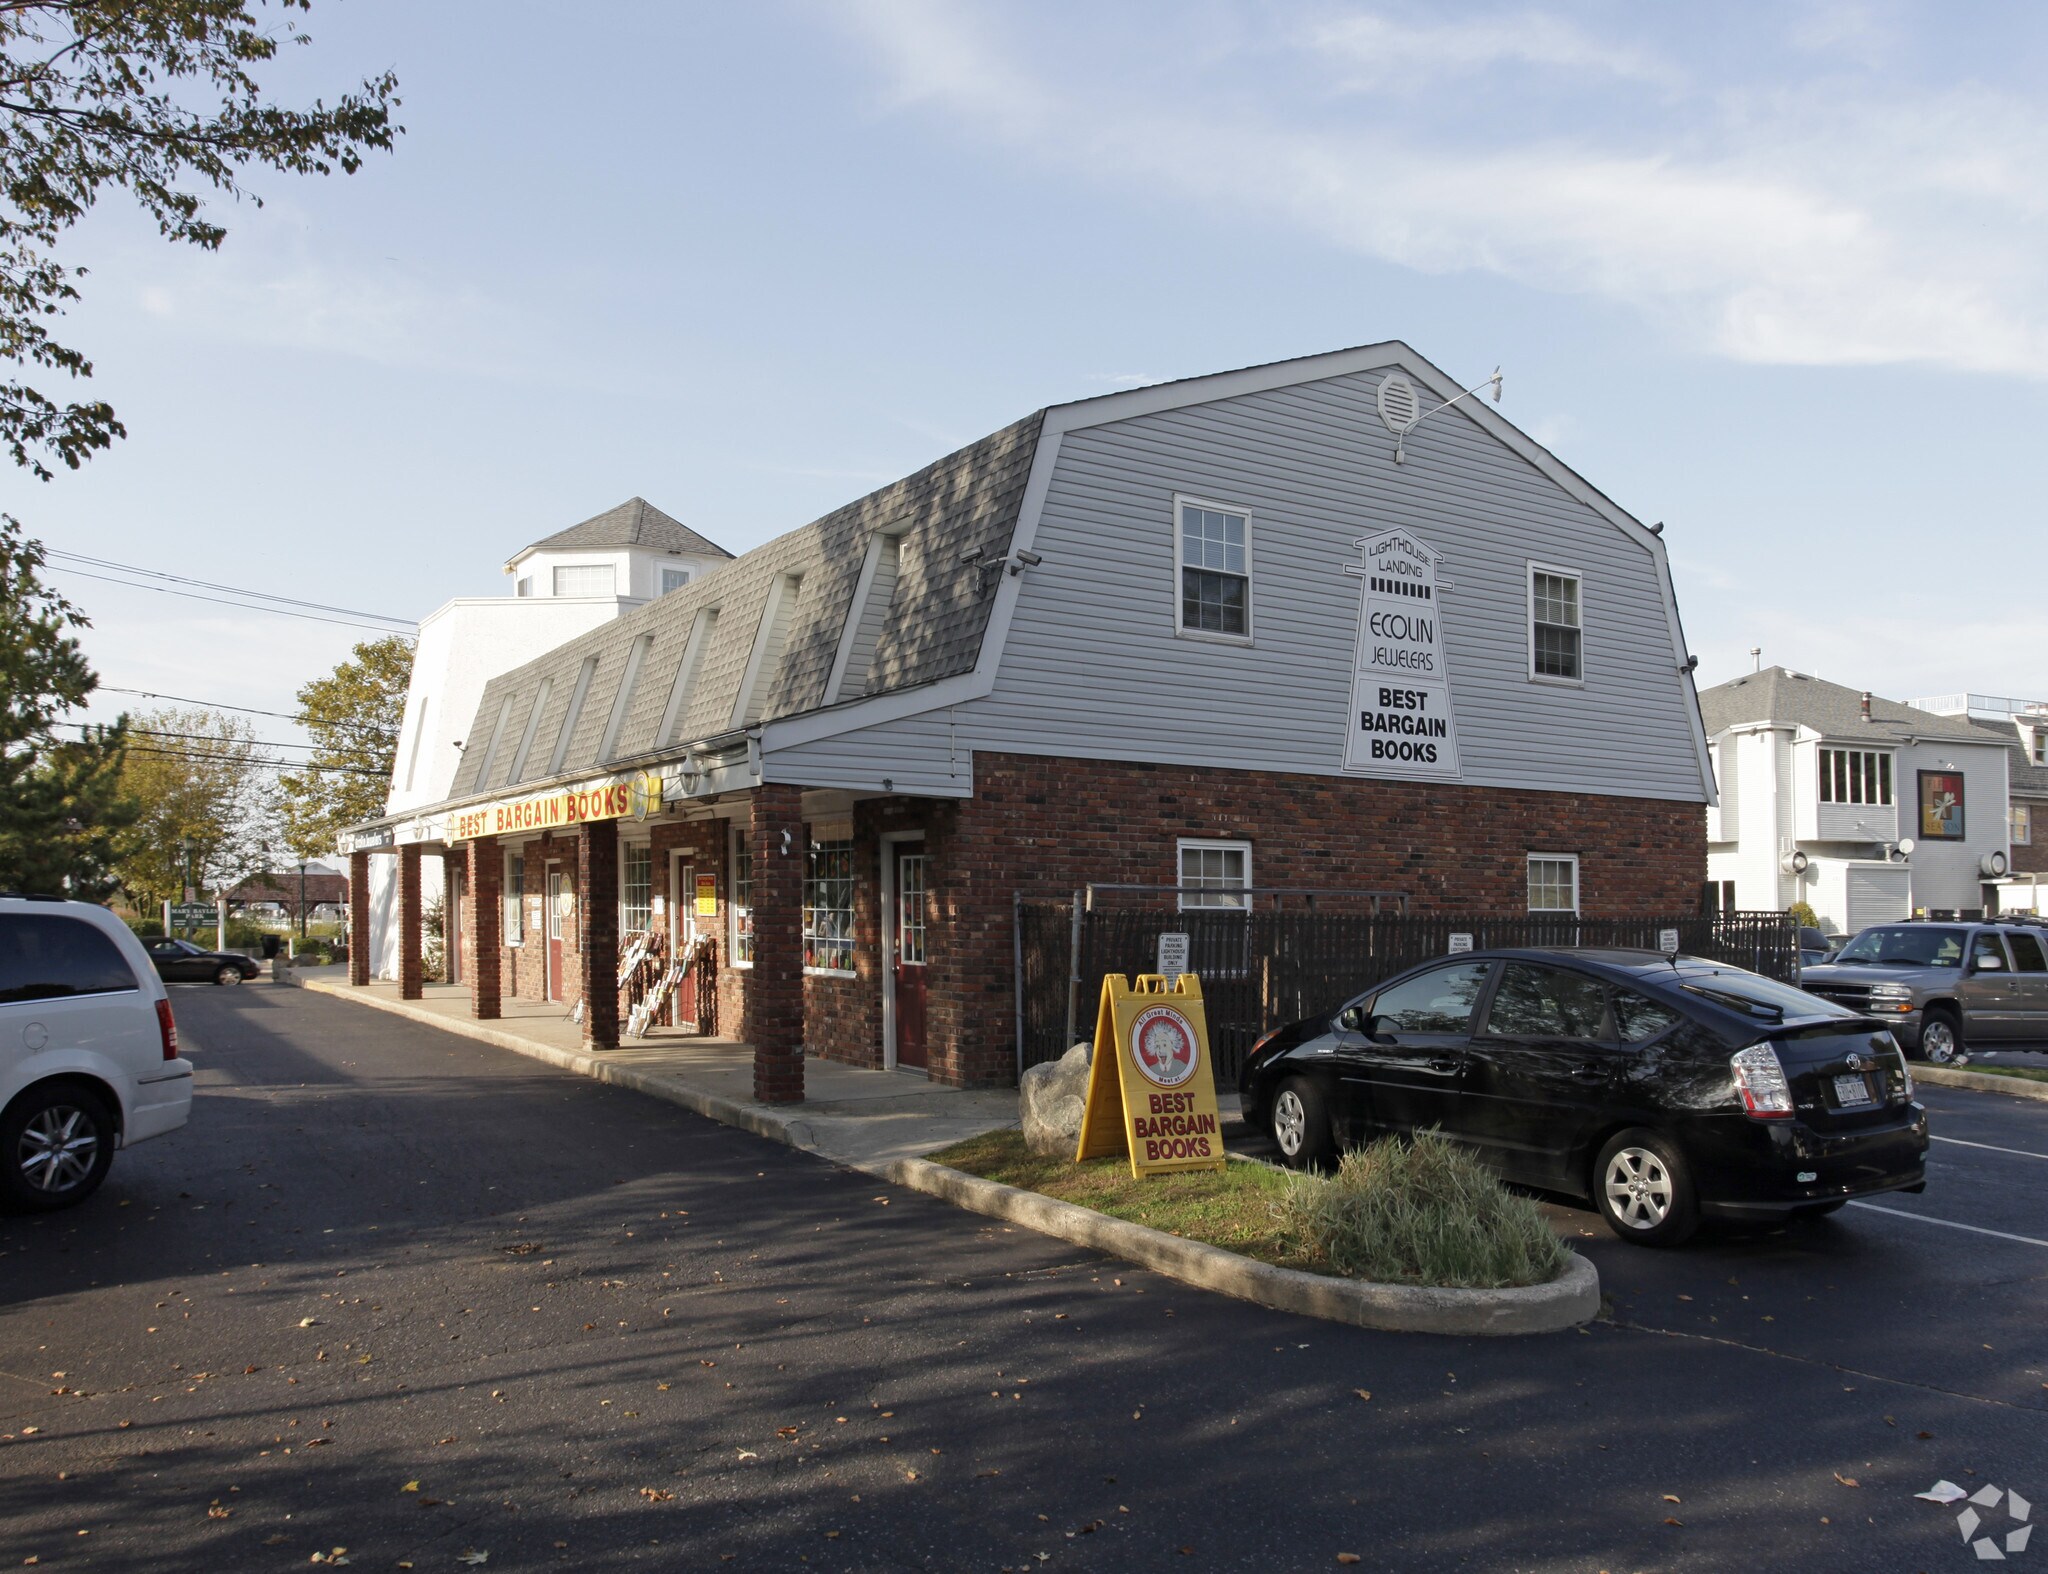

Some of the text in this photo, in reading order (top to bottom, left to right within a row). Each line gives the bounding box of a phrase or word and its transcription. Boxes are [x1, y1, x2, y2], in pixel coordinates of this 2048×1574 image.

[1369, 536, 1431, 568] LIGHTHOUSE
[1378, 558, 1423, 578] LANDING
[1370, 611, 1433, 645] ECOLIN
[1371, 646, 1434, 671] JEWELERS
[1378, 687, 1428, 711] BEST
[1361, 711, 1447, 738] BARGAIN
[1371, 739, 1438, 763] BOOKS
[460, 784, 628, 837] BEST BARGAIN BOOKS
[1926, 822, 1960, 833] SEASON
[1138, 1009, 1183, 1028] All Great Minds
[1158, 1076, 1173, 1084] Meet
[1148, 1092, 1195, 1114] BEST
[1134, 1113, 1216, 1138] BARGAIN
[1146, 1136, 1211, 1160] BOOKS
